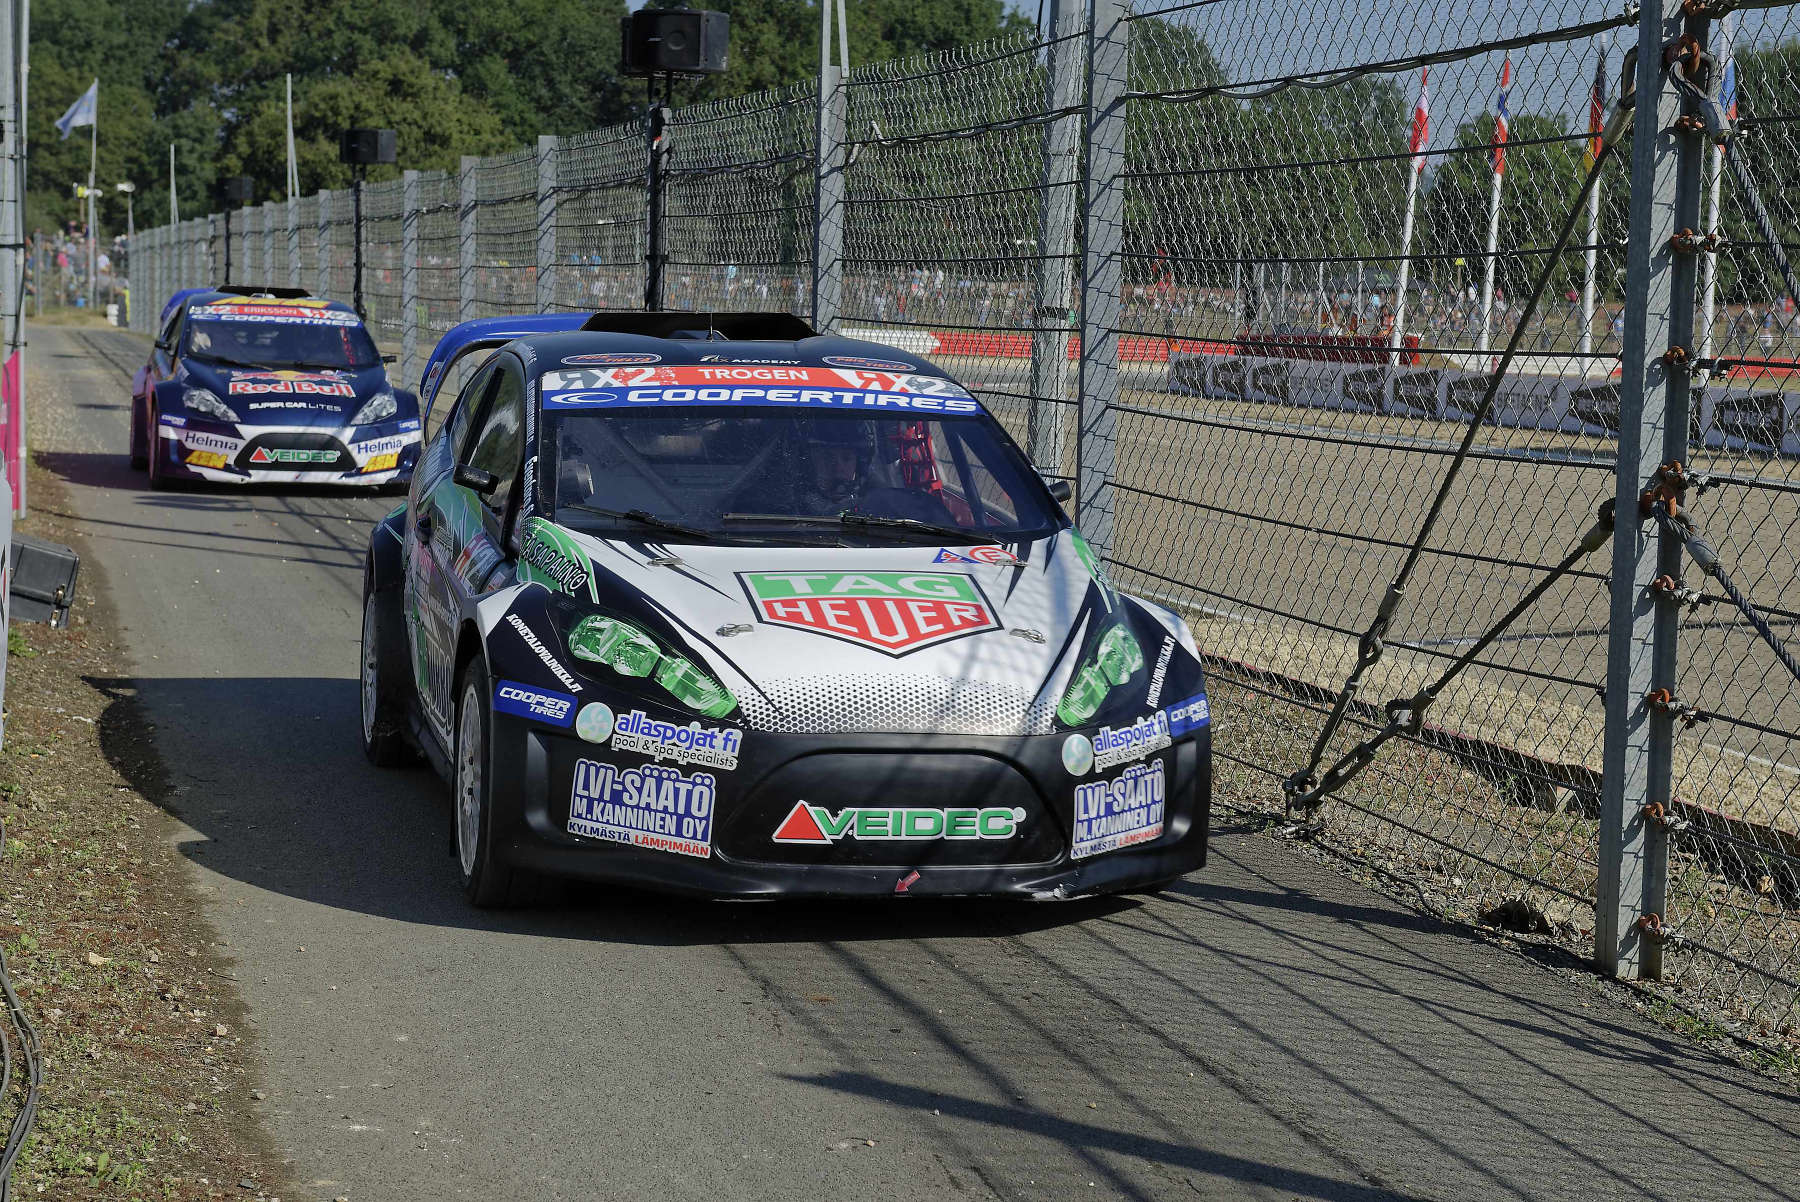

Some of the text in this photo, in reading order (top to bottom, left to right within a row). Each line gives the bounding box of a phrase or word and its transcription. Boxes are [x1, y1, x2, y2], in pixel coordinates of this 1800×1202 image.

[244, 307, 298, 316] ERIKSSON
[697, 368, 809, 381] TROGEN
[229, 381, 356, 398] Red Bull
[308, 403, 342, 412] LITES
[184, 431, 238, 451] Helmia
[357, 440, 402, 454] Helmia
[263, 449, 337, 463] VEIDEC
[763, 574, 960, 598] TAG
[771, 599, 986, 644] HEUER
[499, 686, 571, 713] COOPER
[529, 703, 567, 719] TIRES
[615, 737, 640, 750] pool
[653, 745, 674, 757] spa
[676, 750, 735, 767] specialists
[576, 763, 711, 818] LVI-SÄÄTÖ
[1077, 760, 1164, 821] LVI-SÄÄTÖ
[573, 796, 707, 840] M.KANNINEN OY
[813, 809, 1015, 837] VEIDEC
[1076, 807, 1148, 842] M.KANNINEN
[568, 821, 709, 856] KYLMÄSTÄ LÄMPIMÄÄN
